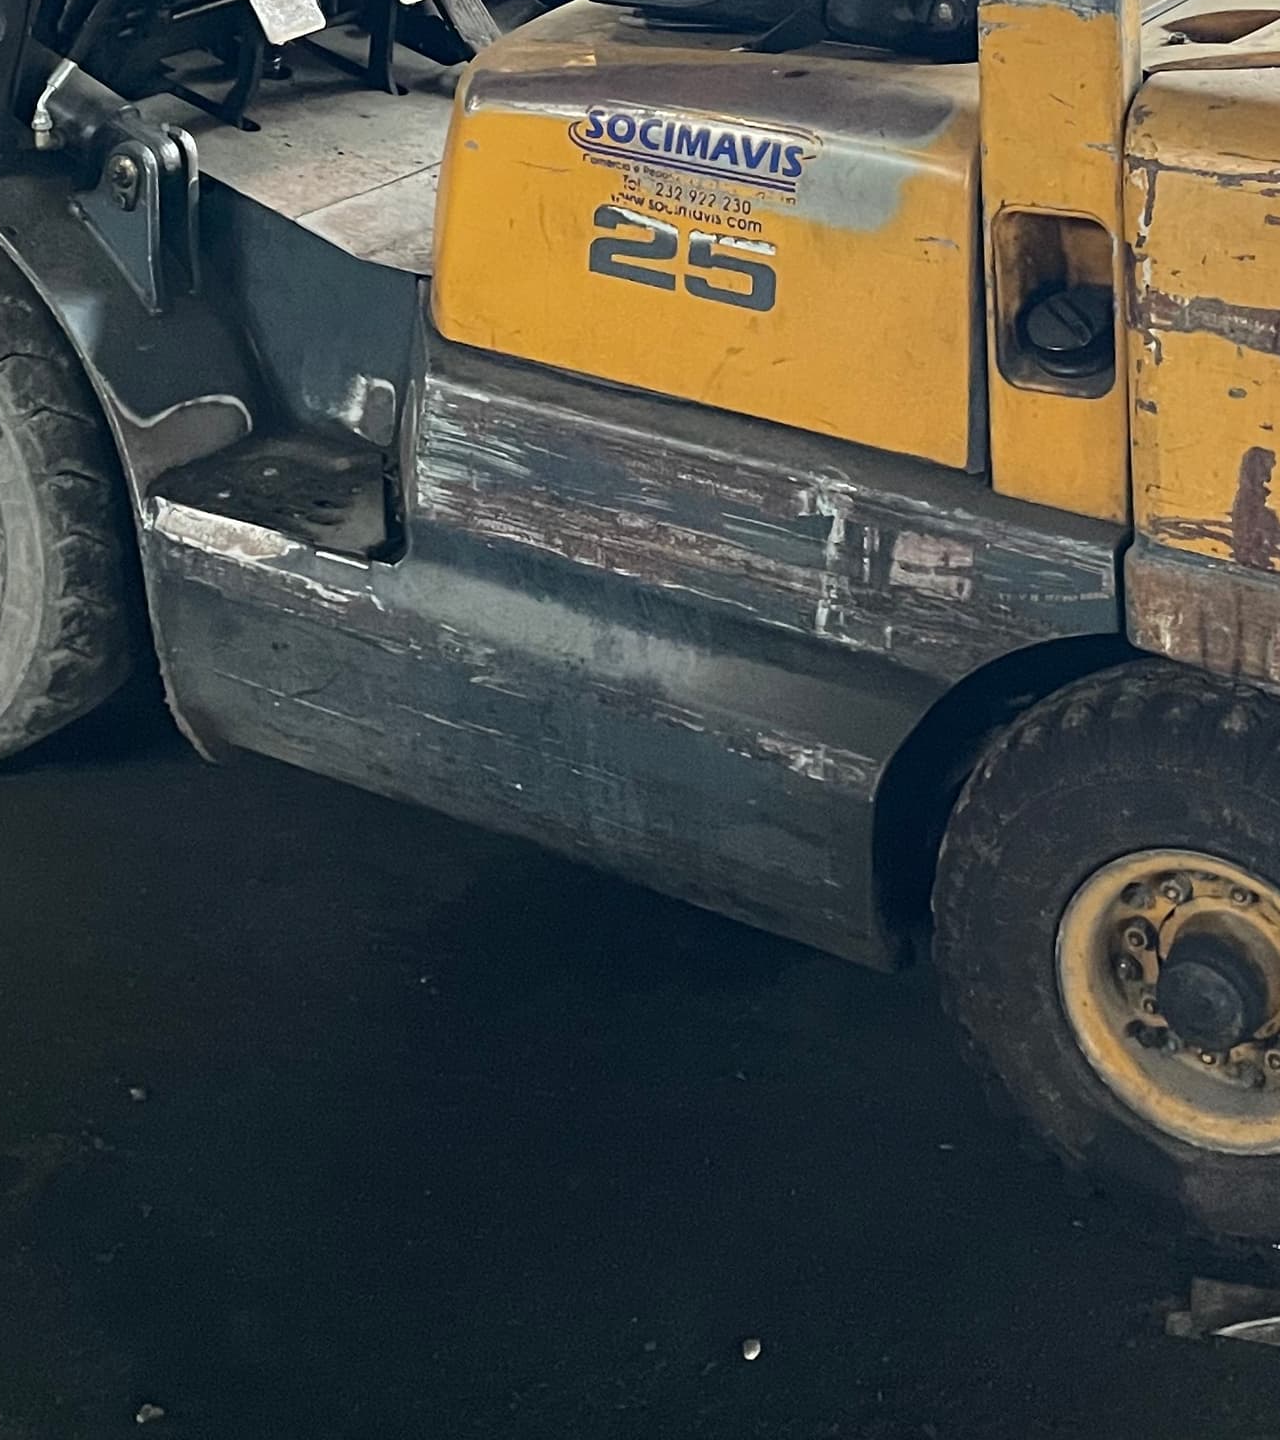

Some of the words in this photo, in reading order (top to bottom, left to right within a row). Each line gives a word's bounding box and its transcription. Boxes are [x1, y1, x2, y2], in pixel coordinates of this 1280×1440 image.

[585, 109, 803, 178] SOCIMAVIS
[655, 182, 682, 201] 232
[688, 189, 717, 208] 922
[723, 195, 752, 216] 230
[589, 203, 776, 312] 25
